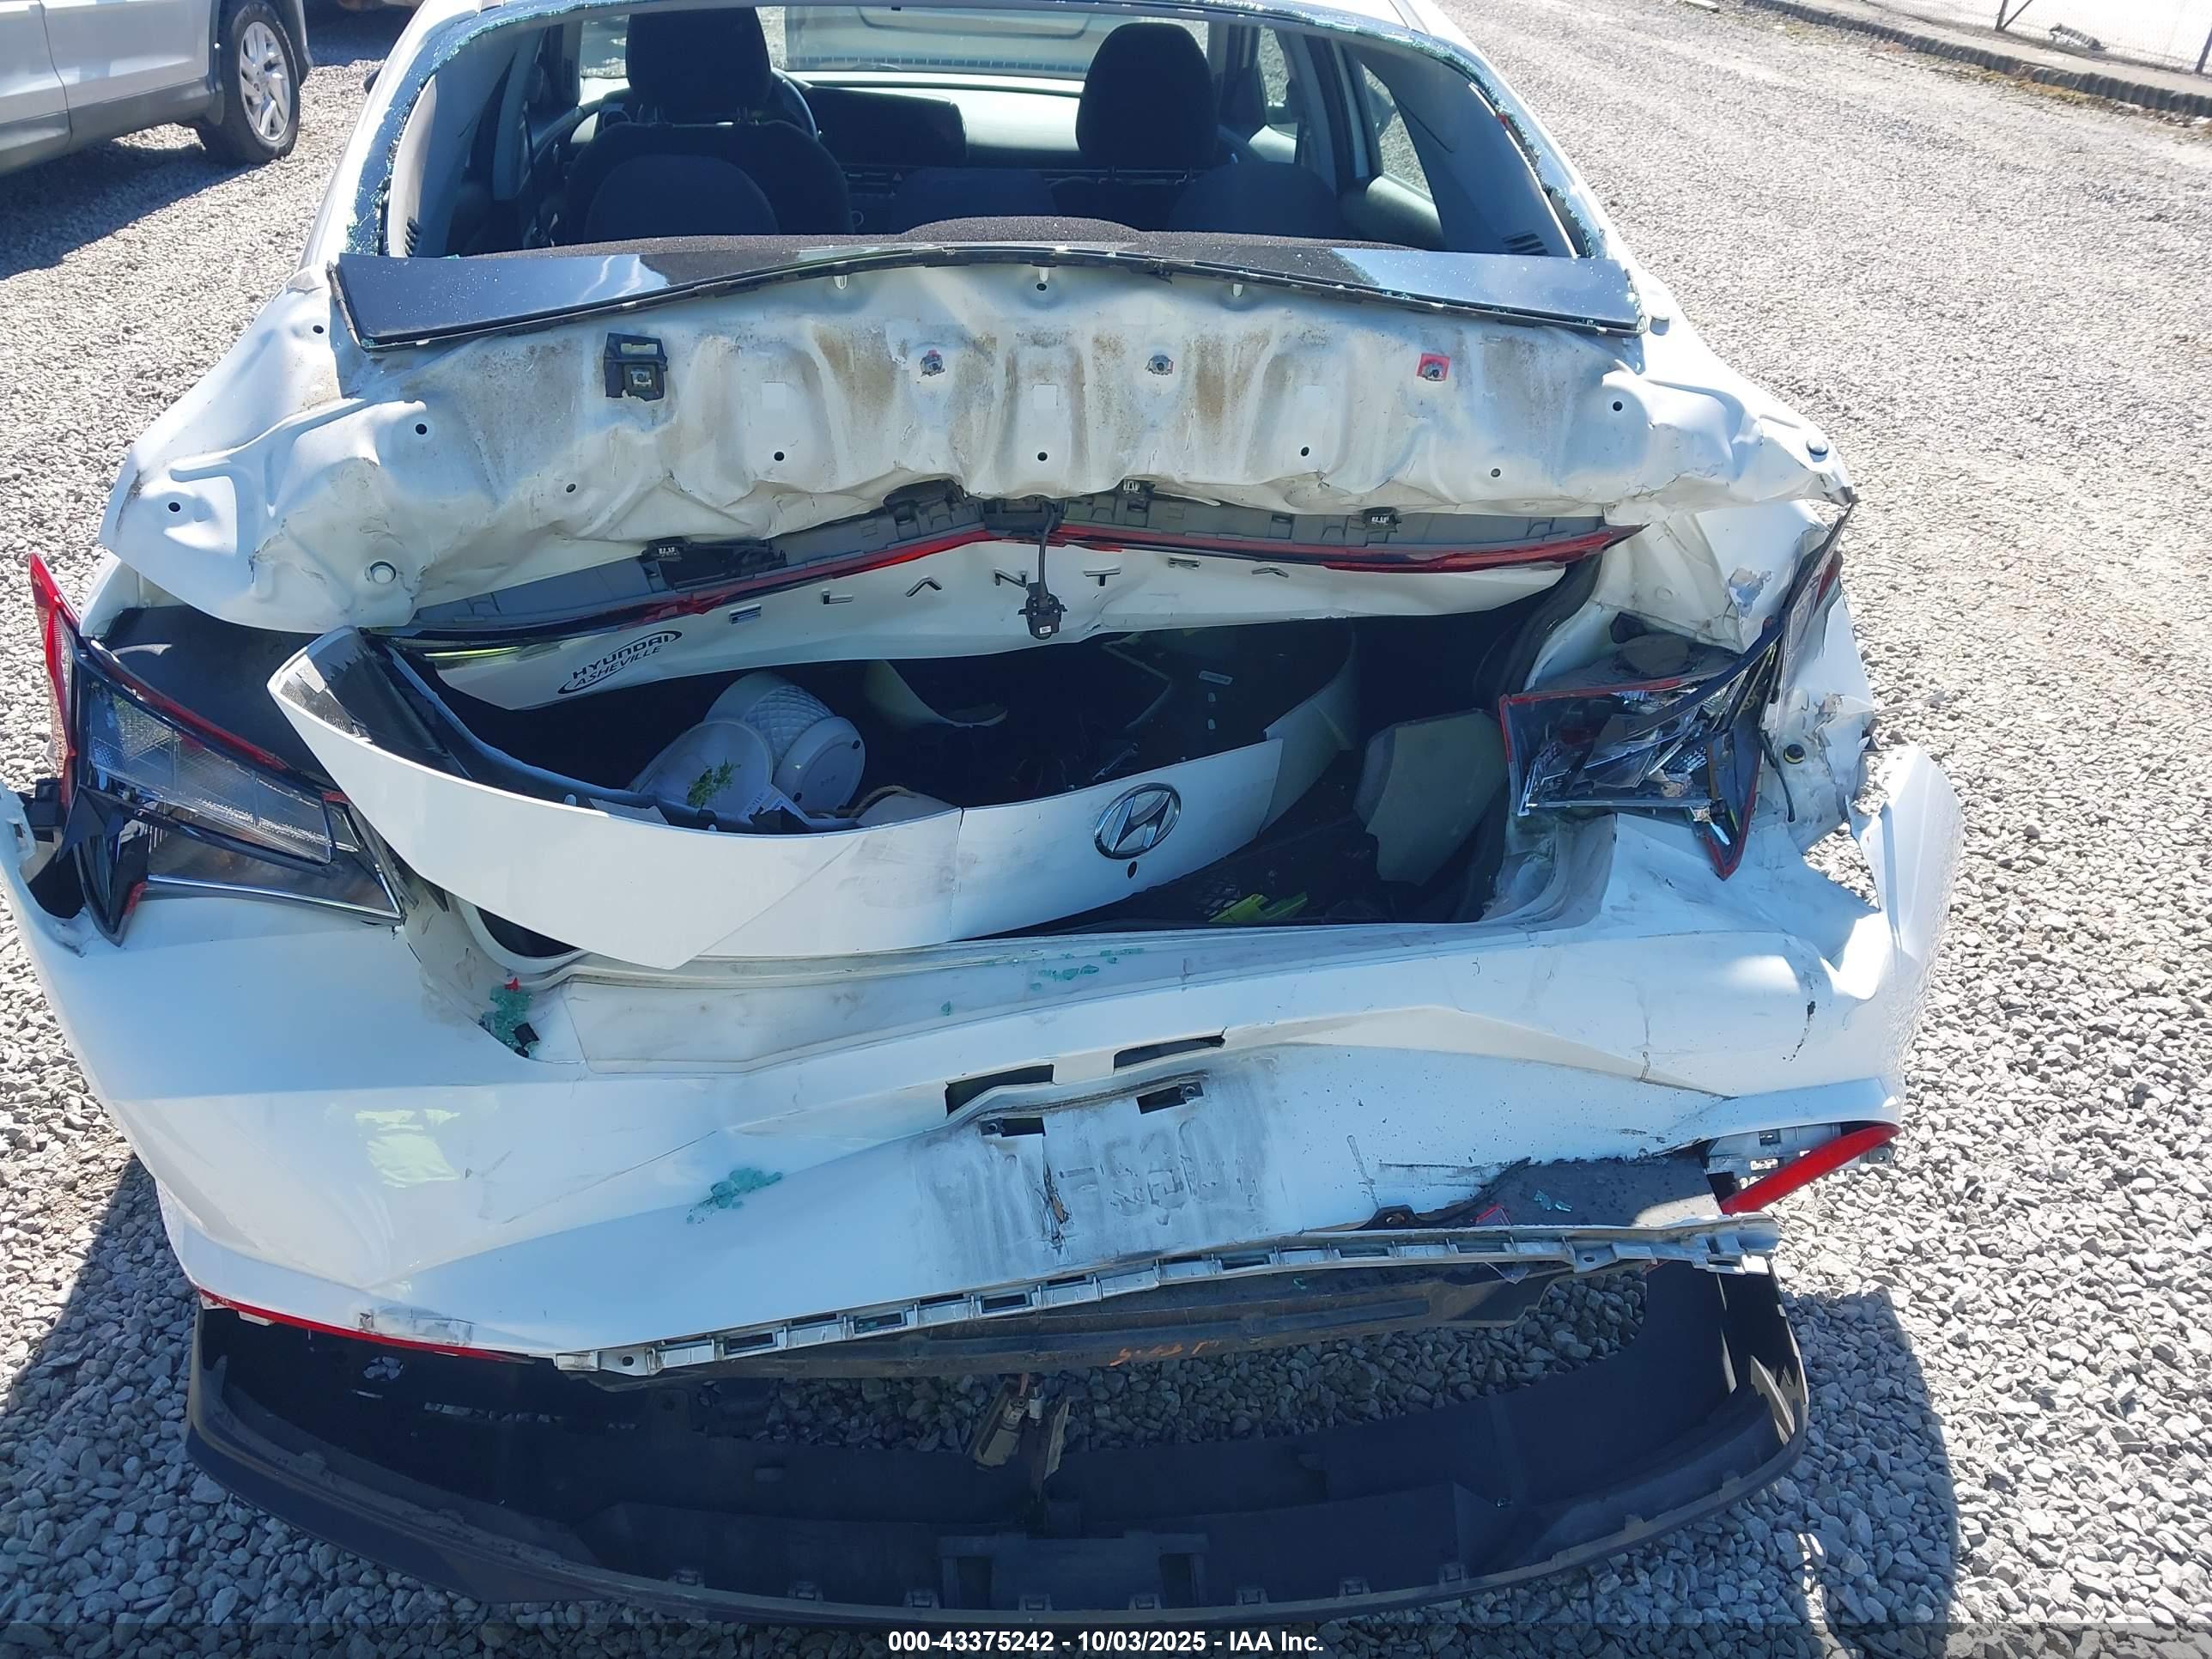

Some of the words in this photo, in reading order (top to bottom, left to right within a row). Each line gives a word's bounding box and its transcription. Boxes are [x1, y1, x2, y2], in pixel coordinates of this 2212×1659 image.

[729, 556, 1289, 625] ELANTRA
[572, 634, 670, 680] HYUNDAI
[573, 645, 663, 688] ASHEVILLE
